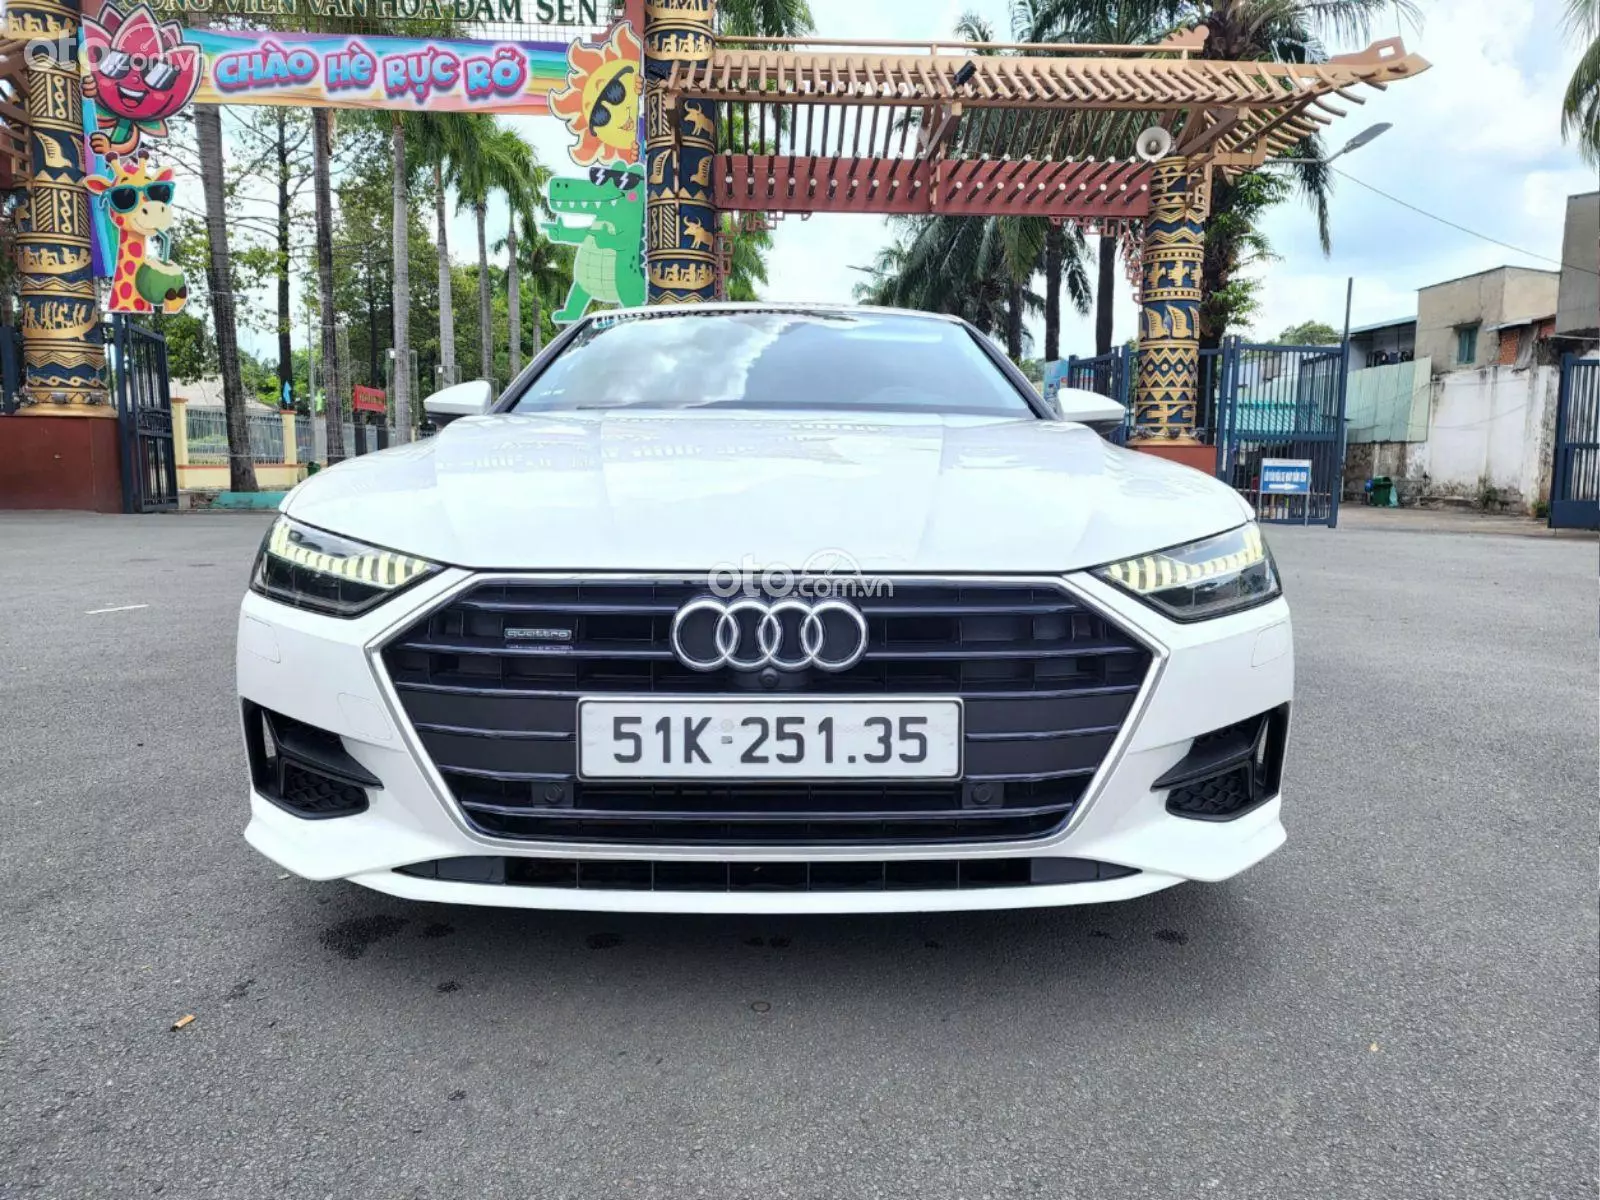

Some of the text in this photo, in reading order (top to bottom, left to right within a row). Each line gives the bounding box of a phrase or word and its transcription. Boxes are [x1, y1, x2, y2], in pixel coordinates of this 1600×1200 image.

[215, 41, 318, 87] CHÀO
[384, 46, 459, 99] RỰC
[506, 629, 570, 638] quattro
[612, 716, 928, 764] 51K-251.35
